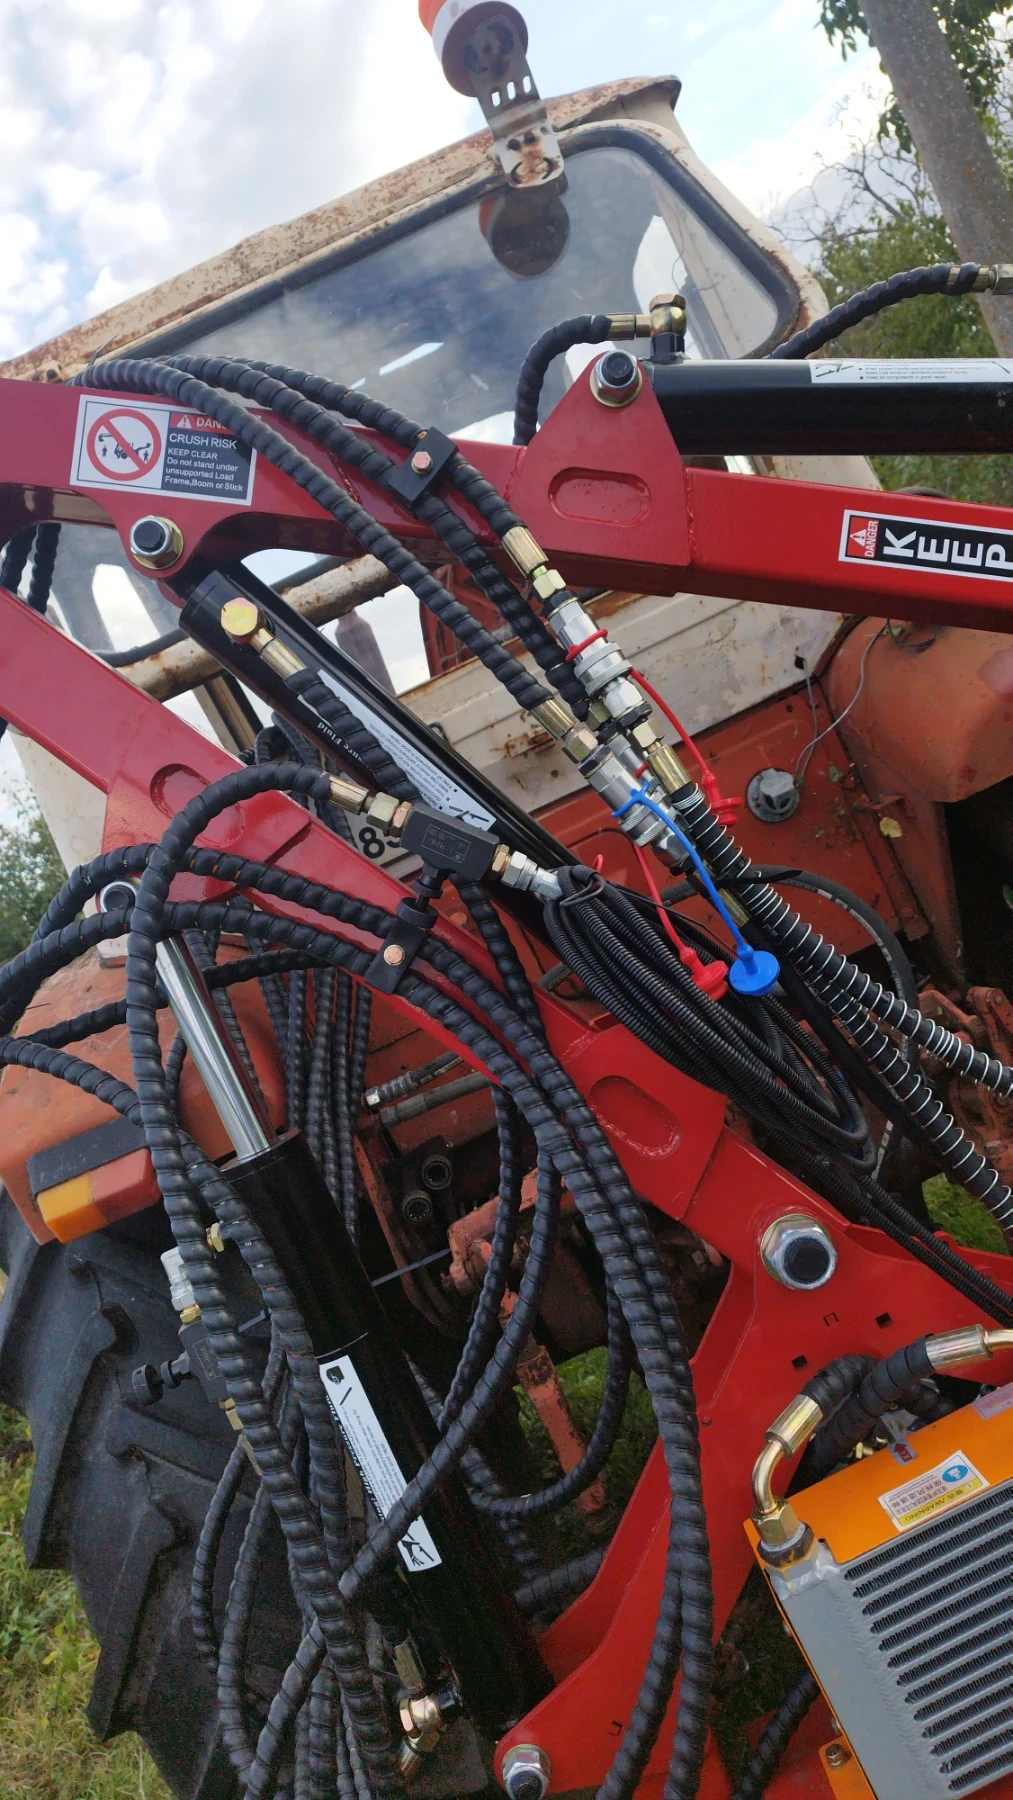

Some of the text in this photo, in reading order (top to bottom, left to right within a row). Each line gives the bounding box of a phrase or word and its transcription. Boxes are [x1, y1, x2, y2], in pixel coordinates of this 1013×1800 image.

[169, 433, 237, 450] CRUSH RISK
[168, 447, 218, 460] KEEP CLEAR
[167, 457, 238, 472] Do not stand under
[166, 466, 234, 482] unsupported Load
[224, 480, 243, 492] Stick
[865, 521, 879, 558] DANGER
[883, 528, 1013, 570] KEEP
[315, 720, 343, 745] Fluid
